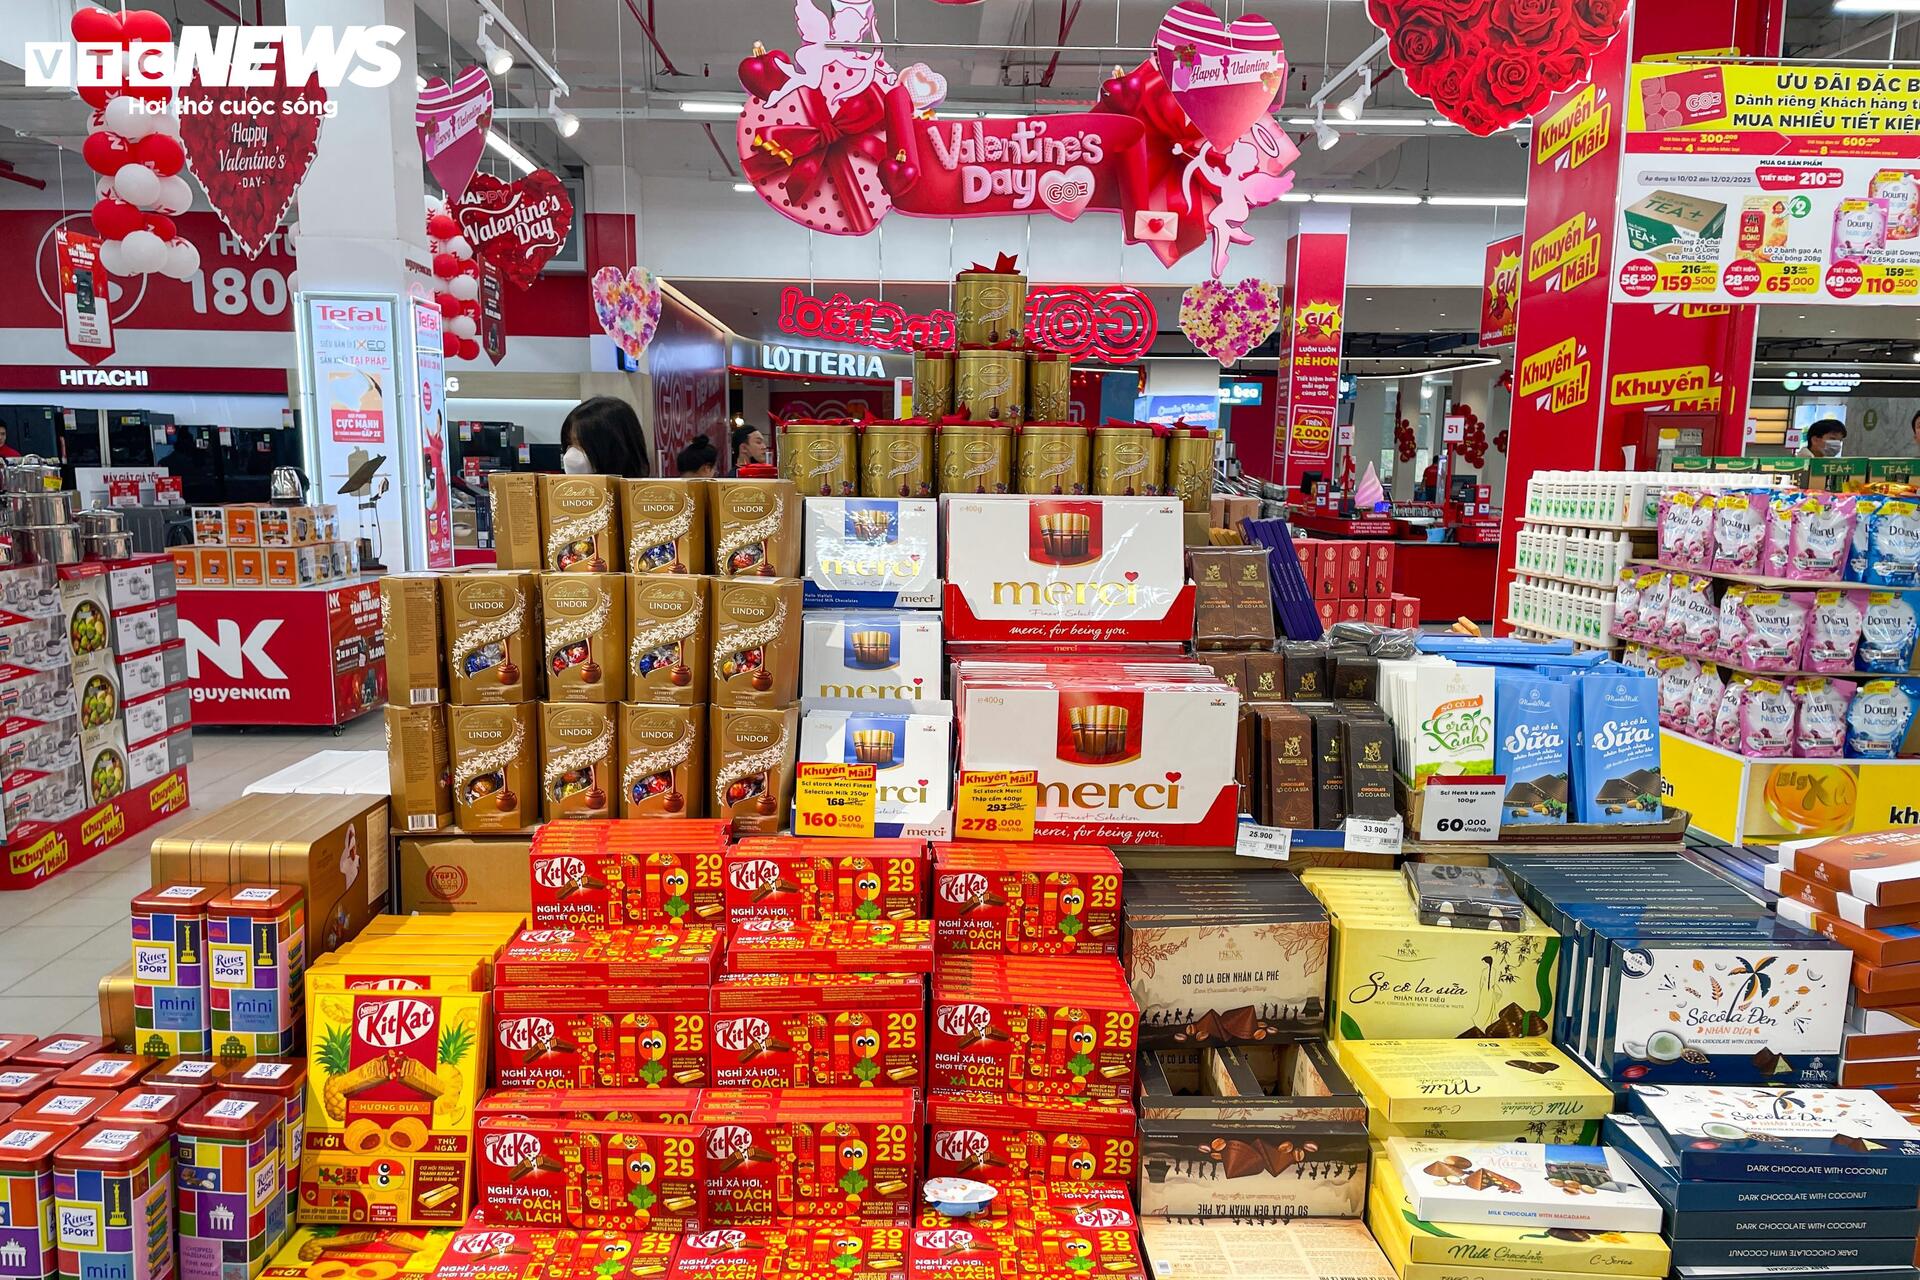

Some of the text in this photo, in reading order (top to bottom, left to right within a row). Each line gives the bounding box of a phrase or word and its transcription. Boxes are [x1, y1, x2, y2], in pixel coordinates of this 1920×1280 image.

[1189, 58, 1271, 84] Happy Valentine
[1776, 73, 1902, 96] ƯU ĐÃI ĐẶC
[1735, 94, 1910, 113] Dành riêng Khách hàng
[1540, 93, 1592, 155] Khuyến
[1733, 113, 1774, 127] MUA
[1778, 108, 1838, 128] NHIỀU
[1841, 110, 1880, 129] TIẾT
[231, 122, 268, 148] Happy
[1574, 107, 1609, 162] Mãi!
[927, 120, 1104, 172] Valentine's
[1685, 143, 1695, 154] 4
[1819, 146, 1829, 155] 8
[218, 146, 287, 174] Valentine's
[961, 164, 1037, 209] Day
[464, 192, 561, 247] Valentine's
[513, 217, 555, 246] Day
[1531, 220, 1582, 272] Khuyến
[1564, 236, 1599, 288] Mãi!
[315, 304, 387, 323] Tefal
[762, 345, 886, 379] LOTTERIA
[1295, 353, 1339, 367] RẺ HƠN
[1522, 344, 1573, 388] Khuyến
[60, 369, 149, 387] HITACHI
[1553, 362, 1587, 410] Mãi!
[1615, 372, 1704, 399] Khuyến
[1294, 427, 1329, 438] 2.000
[1341, 432, 1350, 440] 52
[1447, 424, 1459, 434] 51
[562, 498, 594, 508] LINDOR
[643, 503, 675, 513] LINDOR
[822, 553, 921, 578] merci
[900, 591, 936, 605] merci
[992, 573, 1138, 607] merci
[1008, 624, 1129, 640] merci, for being you.
[178, 618, 289, 680] NK
[1503, 722, 1564, 754] Sữa
[803, 765, 873, 778] Khuyến Mãi!
[1249, 830, 1273, 840] 25.900
[1363, 825, 1388, 834] 33.900
[12, 835, 56, 873] Khuyến
[46, 842, 68, 874] Mãi!
[696, 854, 723, 871] 20
[538, 856, 586, 884] KitKat
[696, 871, 723, 887] 25
[536, 902, 560, 914] NGHỈ
[969, 937, 1002, 951] LÁCH
[138, 951, 167, 966] Ritter
[138, 963, 168, 974] SPORT
[1182, 973, 1192, 985] SÔ
[1194, 972, 1204, 984] CÔ
[1206, 973, 1215, 984] LA
[1217, 972, 1230, 983] ĐEN
[1233, 970, 1252, 983] NHÂN
[1348, 972, 1390, 1004] Sô
[1393, 982, 1411, 994] cô
[1414, 977, 1433, 994] la
[159, 996, 196, 1012] mini
[365, 1000, 432, 1047] KitKat
[359, 1102, 393, 1112] HƯƠNG
[313, 1134, 340, 1148] MỚI
[434, 1145, 459, 1153] NGAY
[437, 1137, 457, 1146] THỬ
[1746, 1163, 1888, 1176] DARK CHOCOLATE WITH COCONUT
[1503, 1210, 1538, 1218] CHOCOLATE
[1447, 1242, 1634, 1268] Milk Chocolate C-Series
